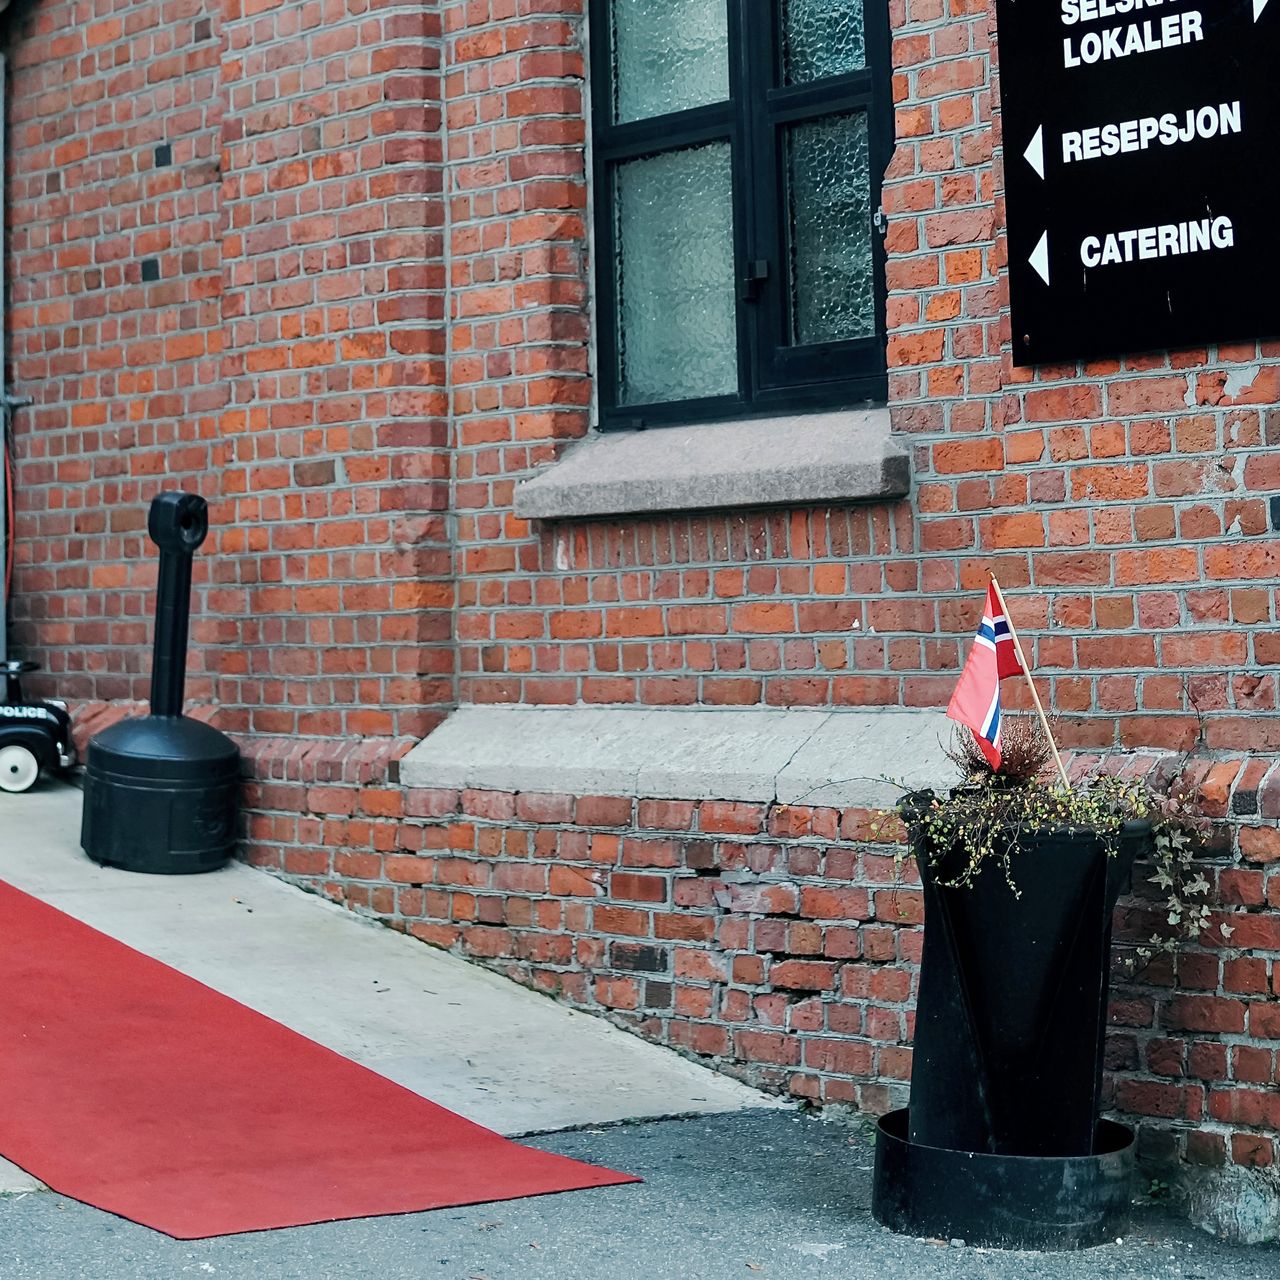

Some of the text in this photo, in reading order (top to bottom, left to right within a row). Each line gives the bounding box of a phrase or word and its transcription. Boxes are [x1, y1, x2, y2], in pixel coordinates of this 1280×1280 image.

[1063, 11, 1204, 69] LOKALER
[1061, 101, 1242, 164] RESEPSJON
[1080, 215, 1234, 268] CATERING
